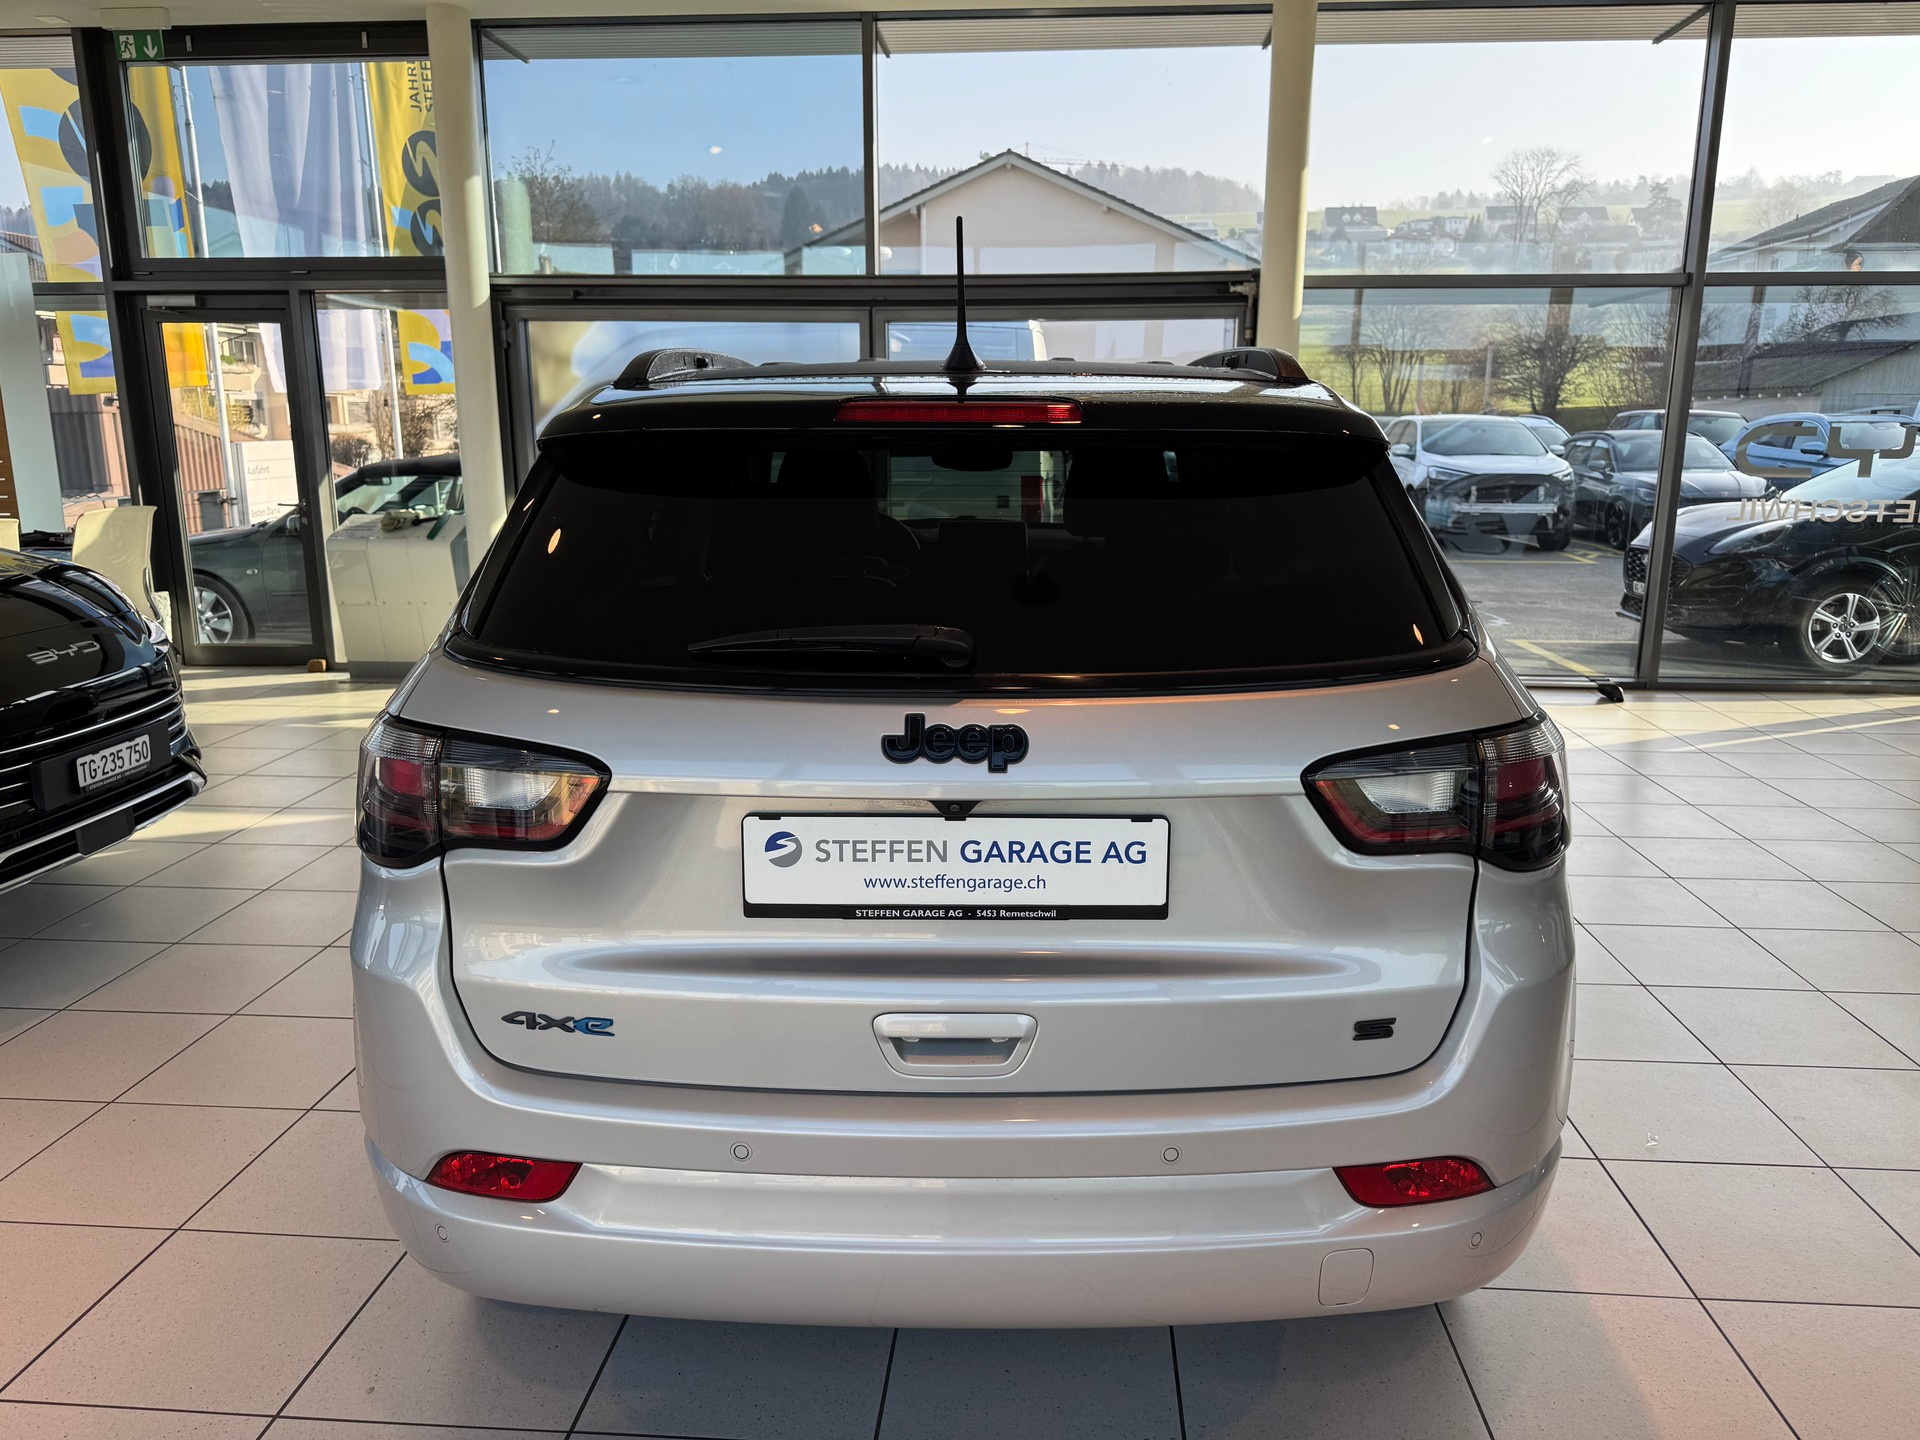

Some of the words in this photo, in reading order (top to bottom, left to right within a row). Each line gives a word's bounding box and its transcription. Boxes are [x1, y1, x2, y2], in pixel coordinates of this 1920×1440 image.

[407, 61, 422, 113] JAHR
[26, 640, 101, 665] BYD
[125, 740, 149, 766] 750
[881, 712, 1029, 774] Jeep
[815, 838, 948, 864] STEFFEN
[959, 839, 1092, 865] GARAGE
[1101, 840, 1148, 865] AG
[863, 873, 1047, 893] www.steffengarage.ch
[855, 909, 900, 918] STEFFEN
[902, 909, 946, 918] GARAGE
[947, 909, 963, 918] AG
[976, 909, 997, 918] 5453
[999, 909, 1057, 918] Remetschwil
[1352, 1017, 1397, 1041] S
